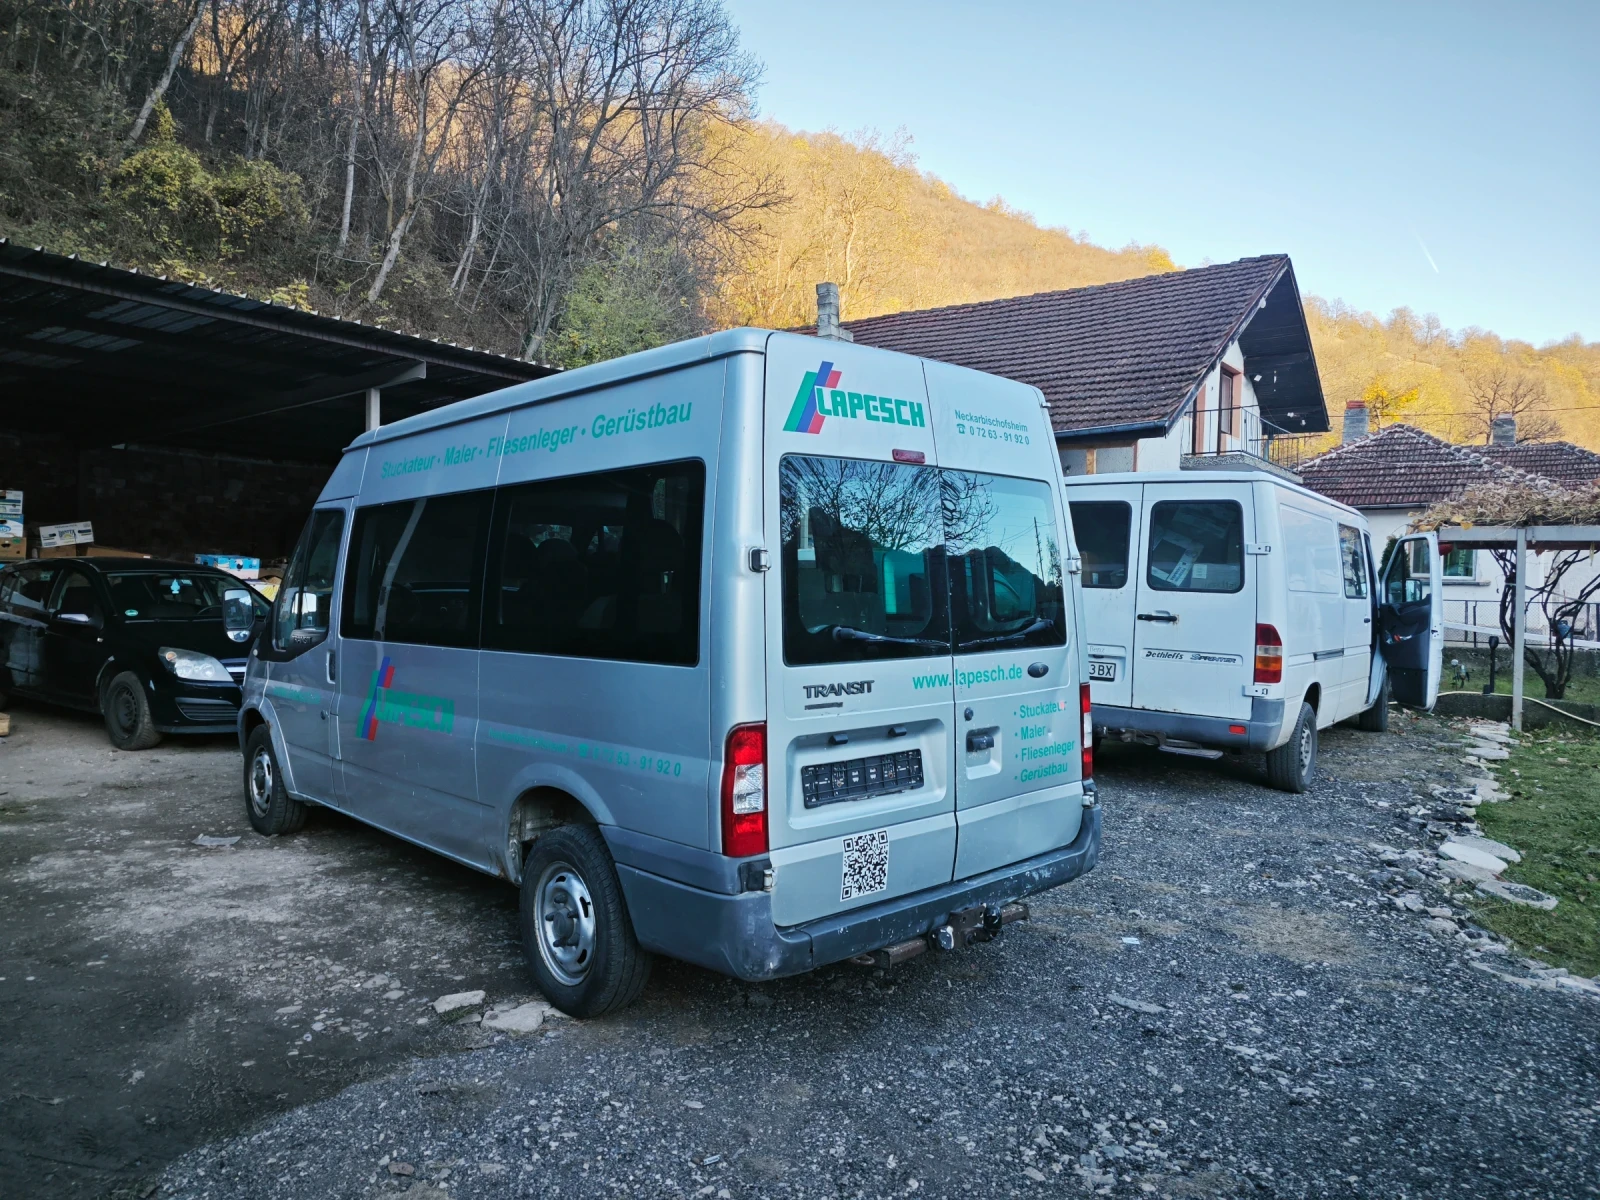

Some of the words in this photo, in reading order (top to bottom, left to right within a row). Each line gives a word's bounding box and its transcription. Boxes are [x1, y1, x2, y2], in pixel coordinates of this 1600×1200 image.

[815, 386, 925, 428] LAPESCH
[955, 409, 1028, 432] Neckarbischofsheim
[381, 455, 436, 479] Stuckateur
[444, 444, 478, 466] Maler
[486, 425, 578, 459] Fliesenleger
[592, 402, 692, 439] Gerüstbau
[1146, 650, 1184, 660] Dethleffs
[913, 663, 1023, 688] www.lapesch.de
[803, 680, 875, 699] TRANSIT
[1021, 724, 1046, 740] Maler
[1021, 740, 1075, 762] Fliesenleger
[1020, 761, 1068, 782] Gerüstbau
